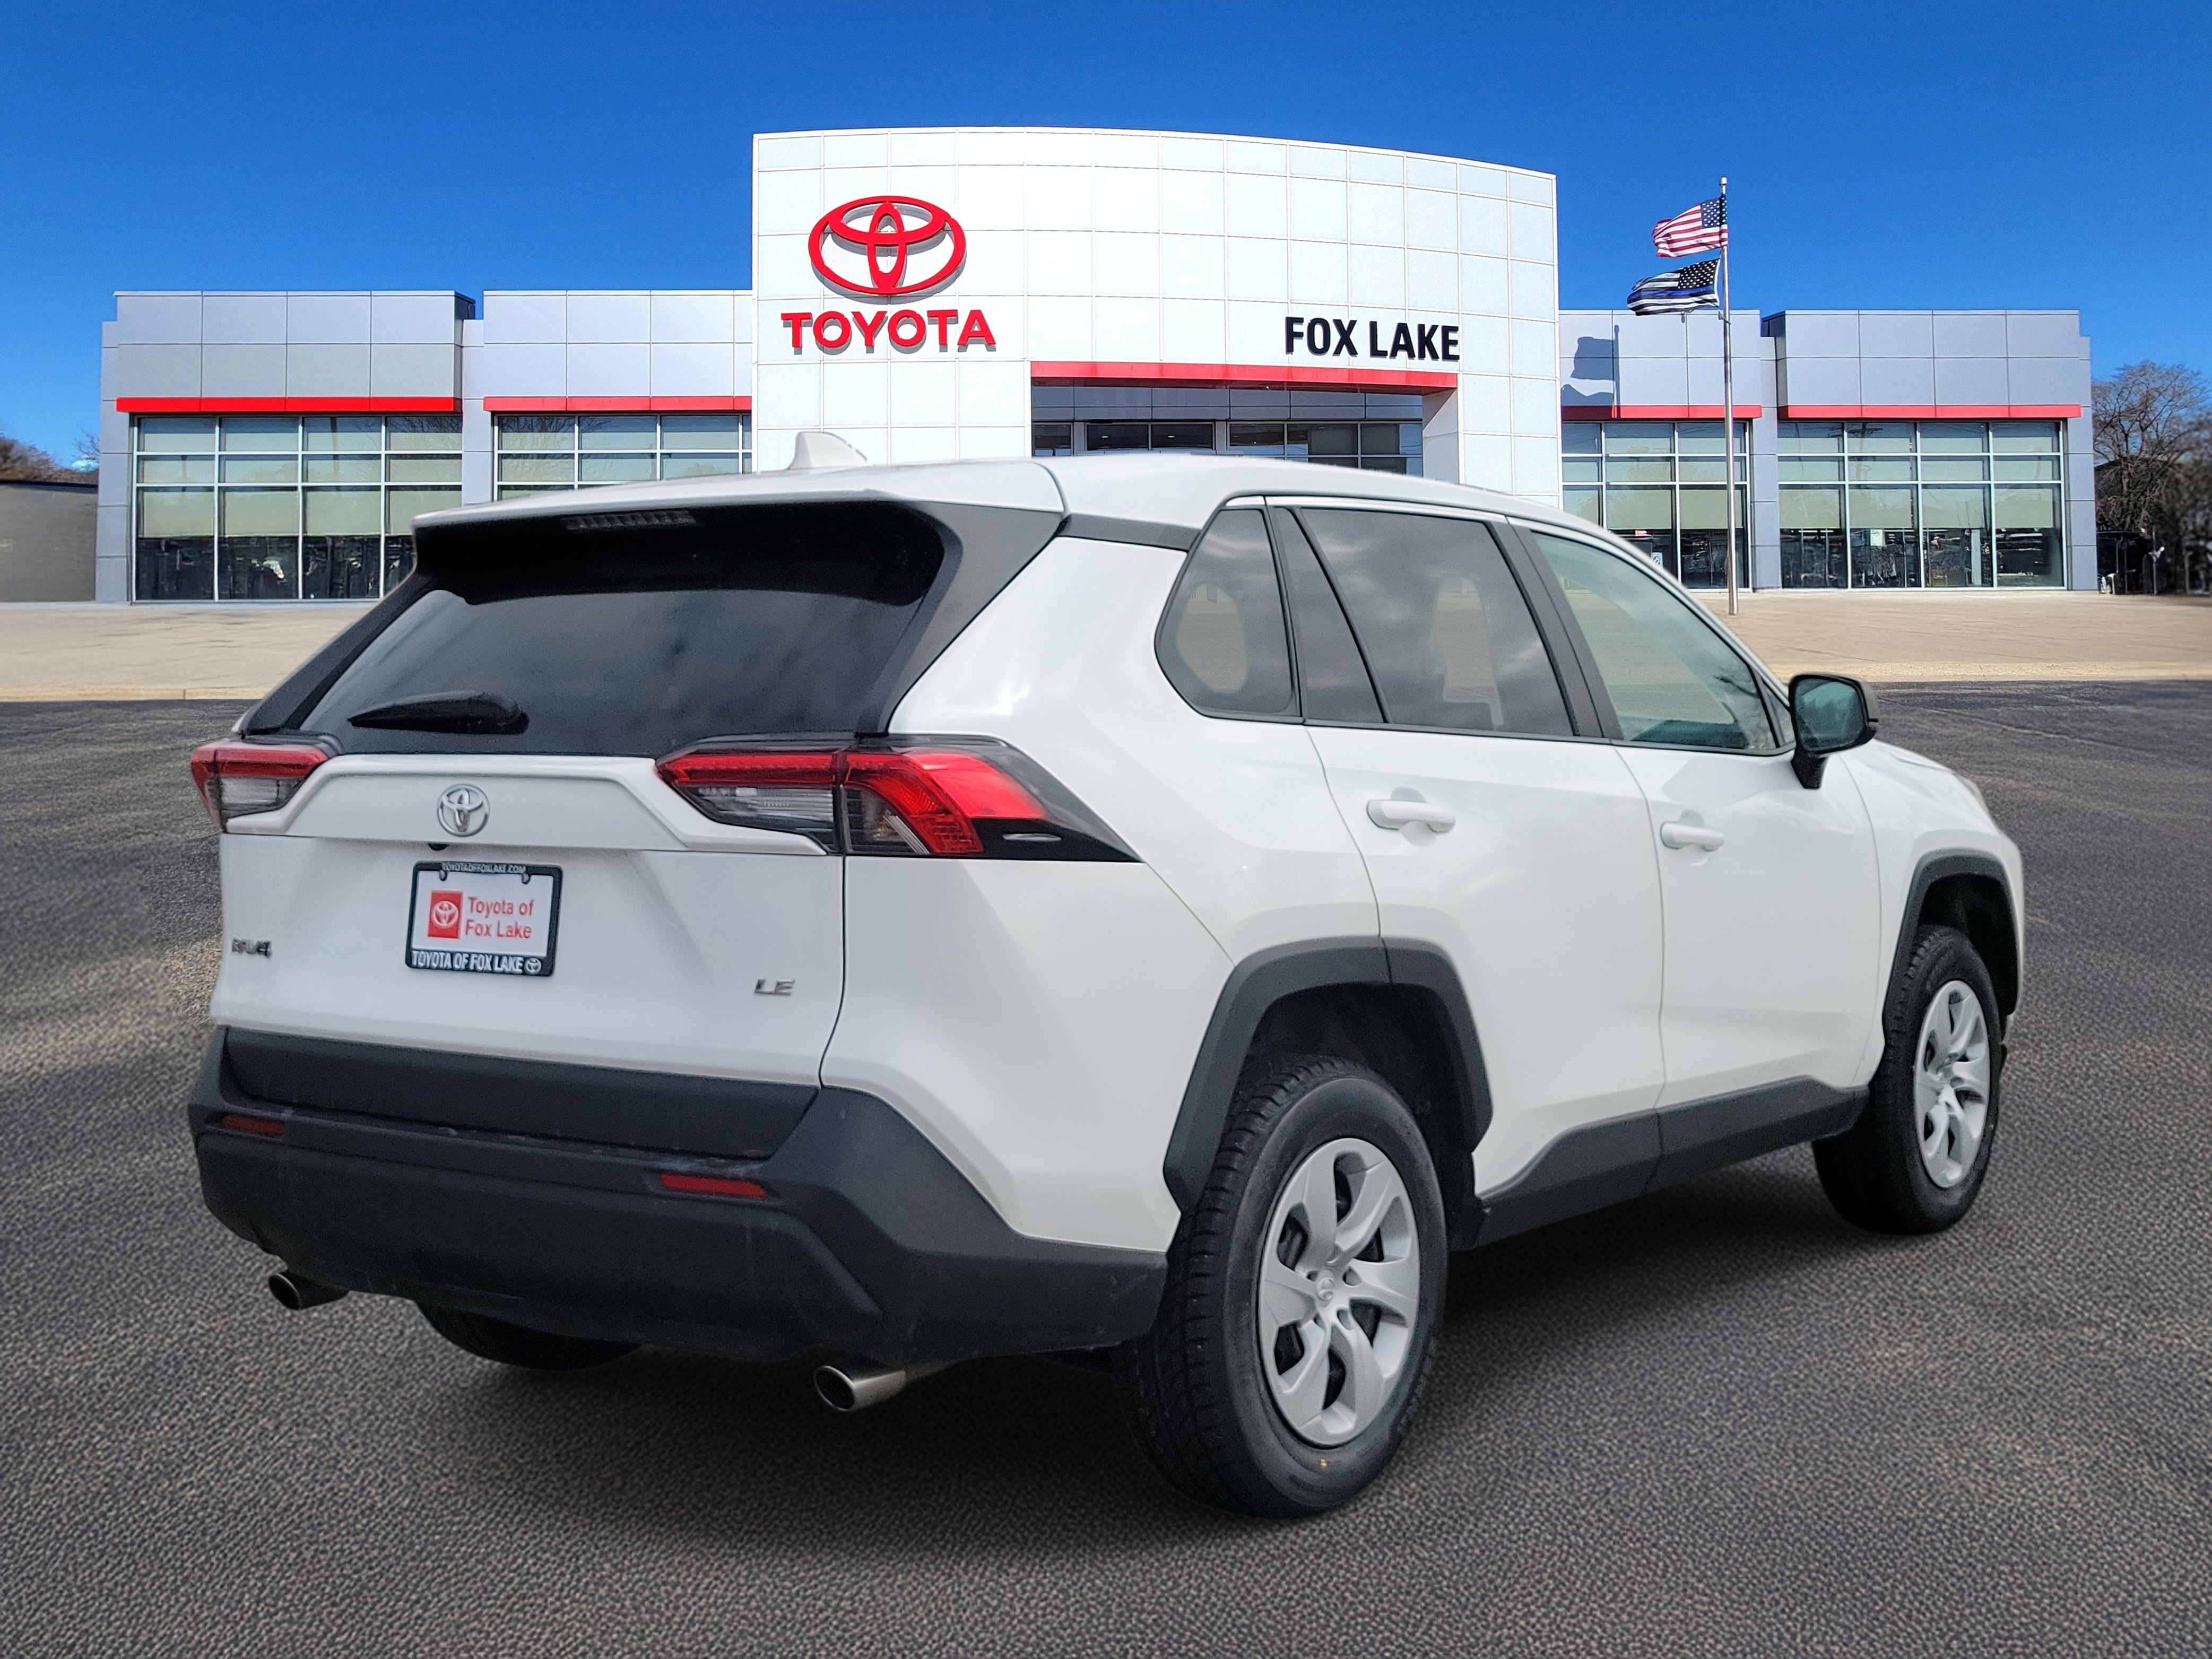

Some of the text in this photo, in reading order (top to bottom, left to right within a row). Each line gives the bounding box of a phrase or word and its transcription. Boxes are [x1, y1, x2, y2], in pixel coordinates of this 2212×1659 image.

[780, 309, 996, 354] TOYOTA
[1285, 317, 1460, 361] FOX LAKE
[467, 897, 535, 918] Toyota of
[464, 919, 532, 939] Fox Lake
[411, 950, 524, 974] TOYOTA OF FOX LAKE
[754, 979, 795, 996] LE
